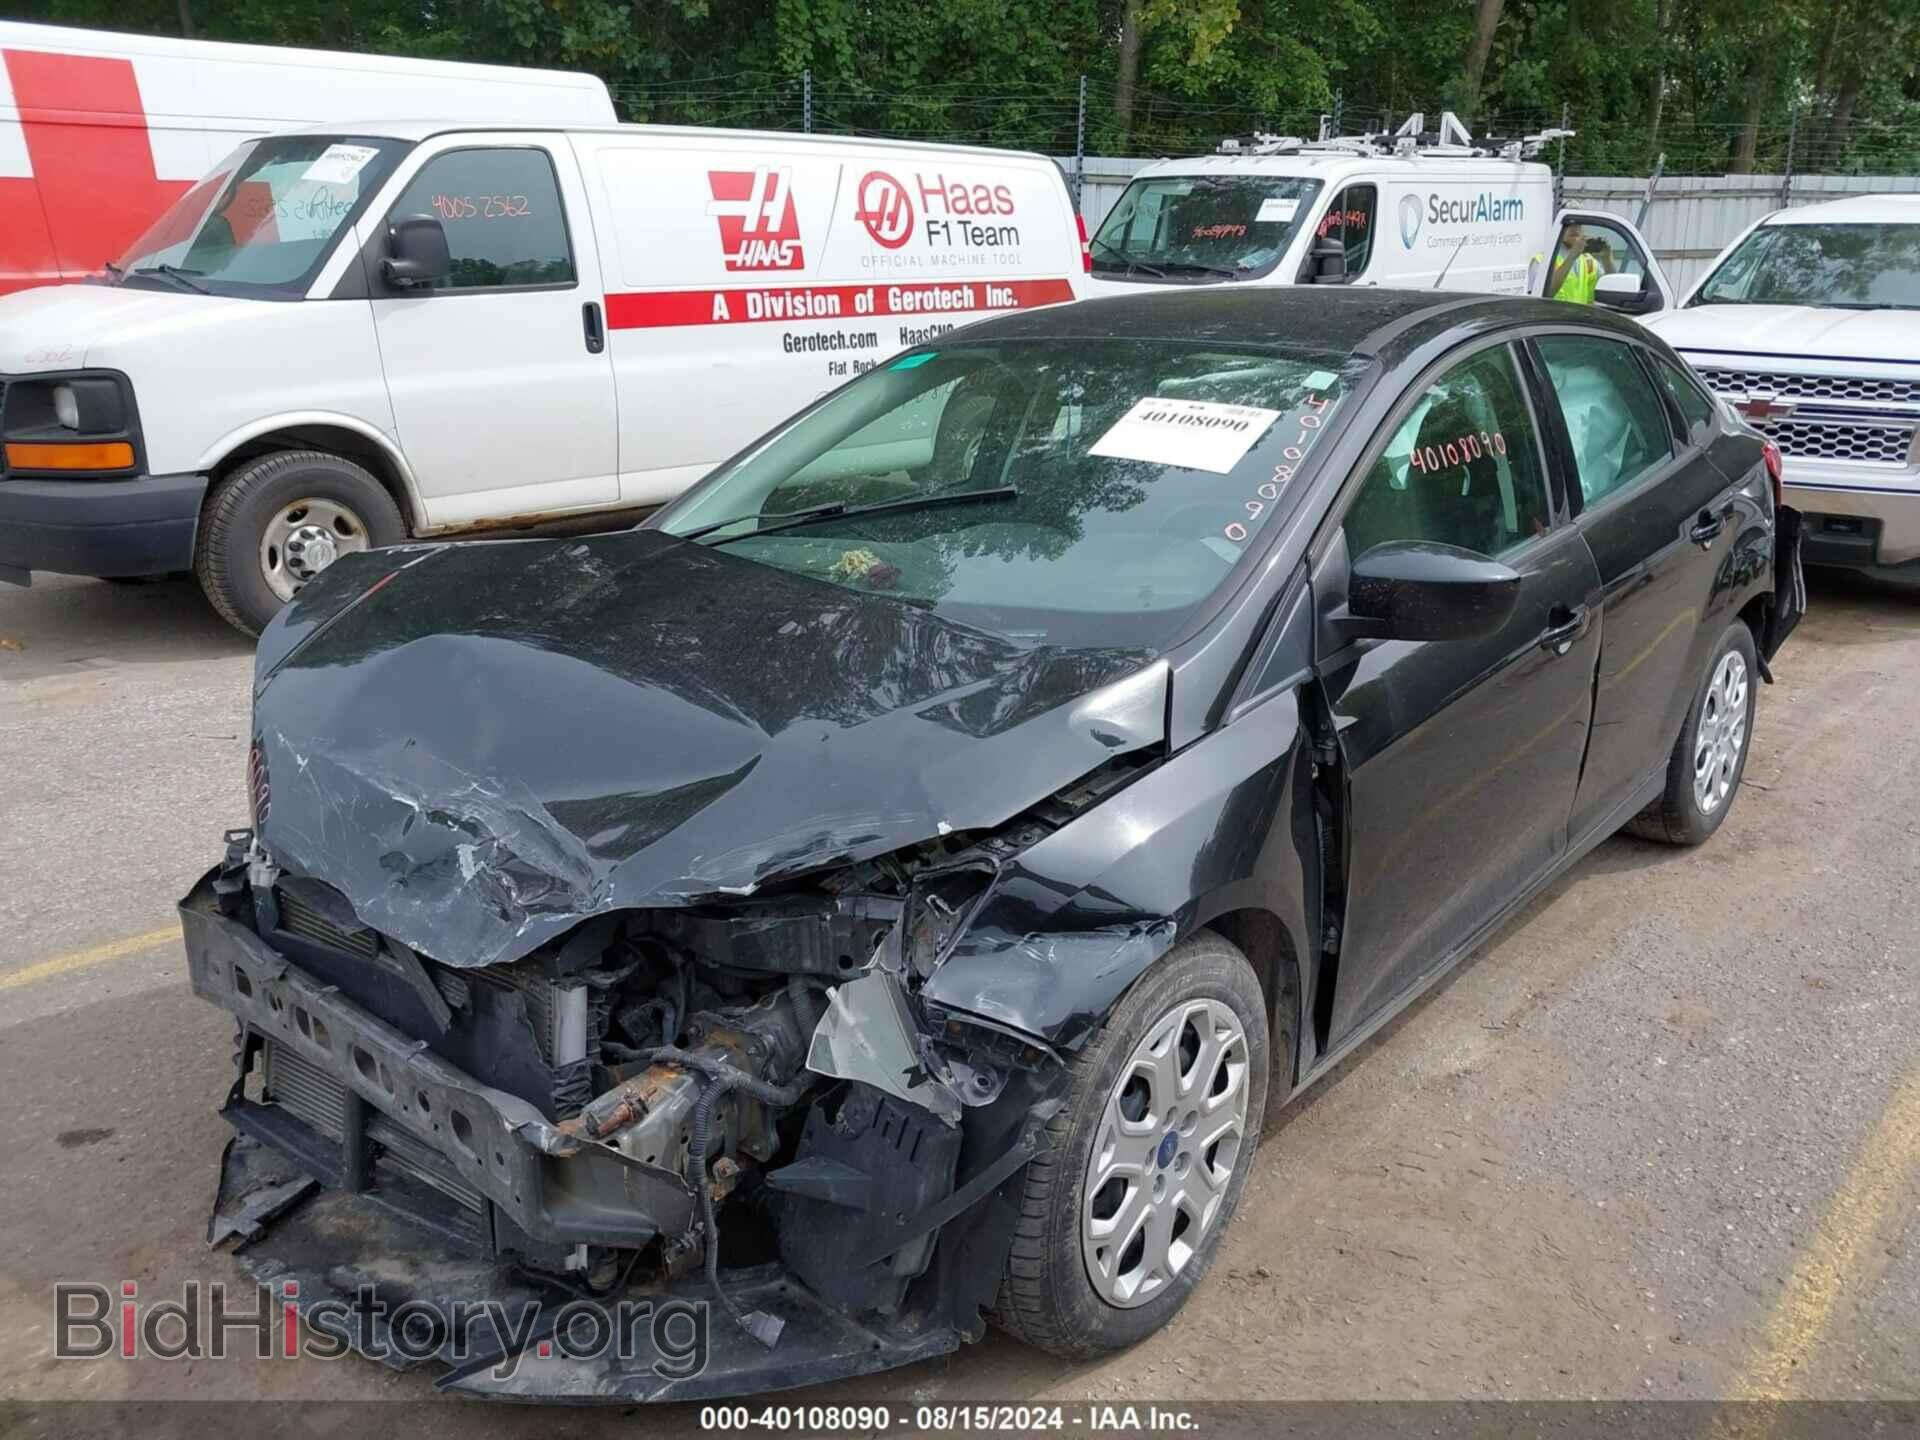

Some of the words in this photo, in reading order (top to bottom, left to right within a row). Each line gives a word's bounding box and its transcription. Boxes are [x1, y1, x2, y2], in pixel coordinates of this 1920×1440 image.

[915, 173, 1015, 215] Haas
[1428, 191, 1524, 224] SecurAlarm
[926, 220, 952, 246] F1
[957, 220, 1020, 246] Team
[724, 239, 801, 267] HAAS
[861, 255, 924, 268] OFFICIAL
[931, 253, 985, 266] MACHINE
[993, 253, 1023, 265] TOOL
[712, 293, 730, 320] A
[747, 290, 841, 319] Division
[855, 288, 875, 313] of
[888, 285, 975, 312] Gerotech
[986, 287, 1018, 307] Inc.
[783, 330, 878, 353] Gerotech.com
[828, 362, 847, 376] Flat
[1138, 410, 1250, 433] 40108090
[1224, 393, 1329, 541] 40108090
[1409, 431, 1506, 475] 40108090
